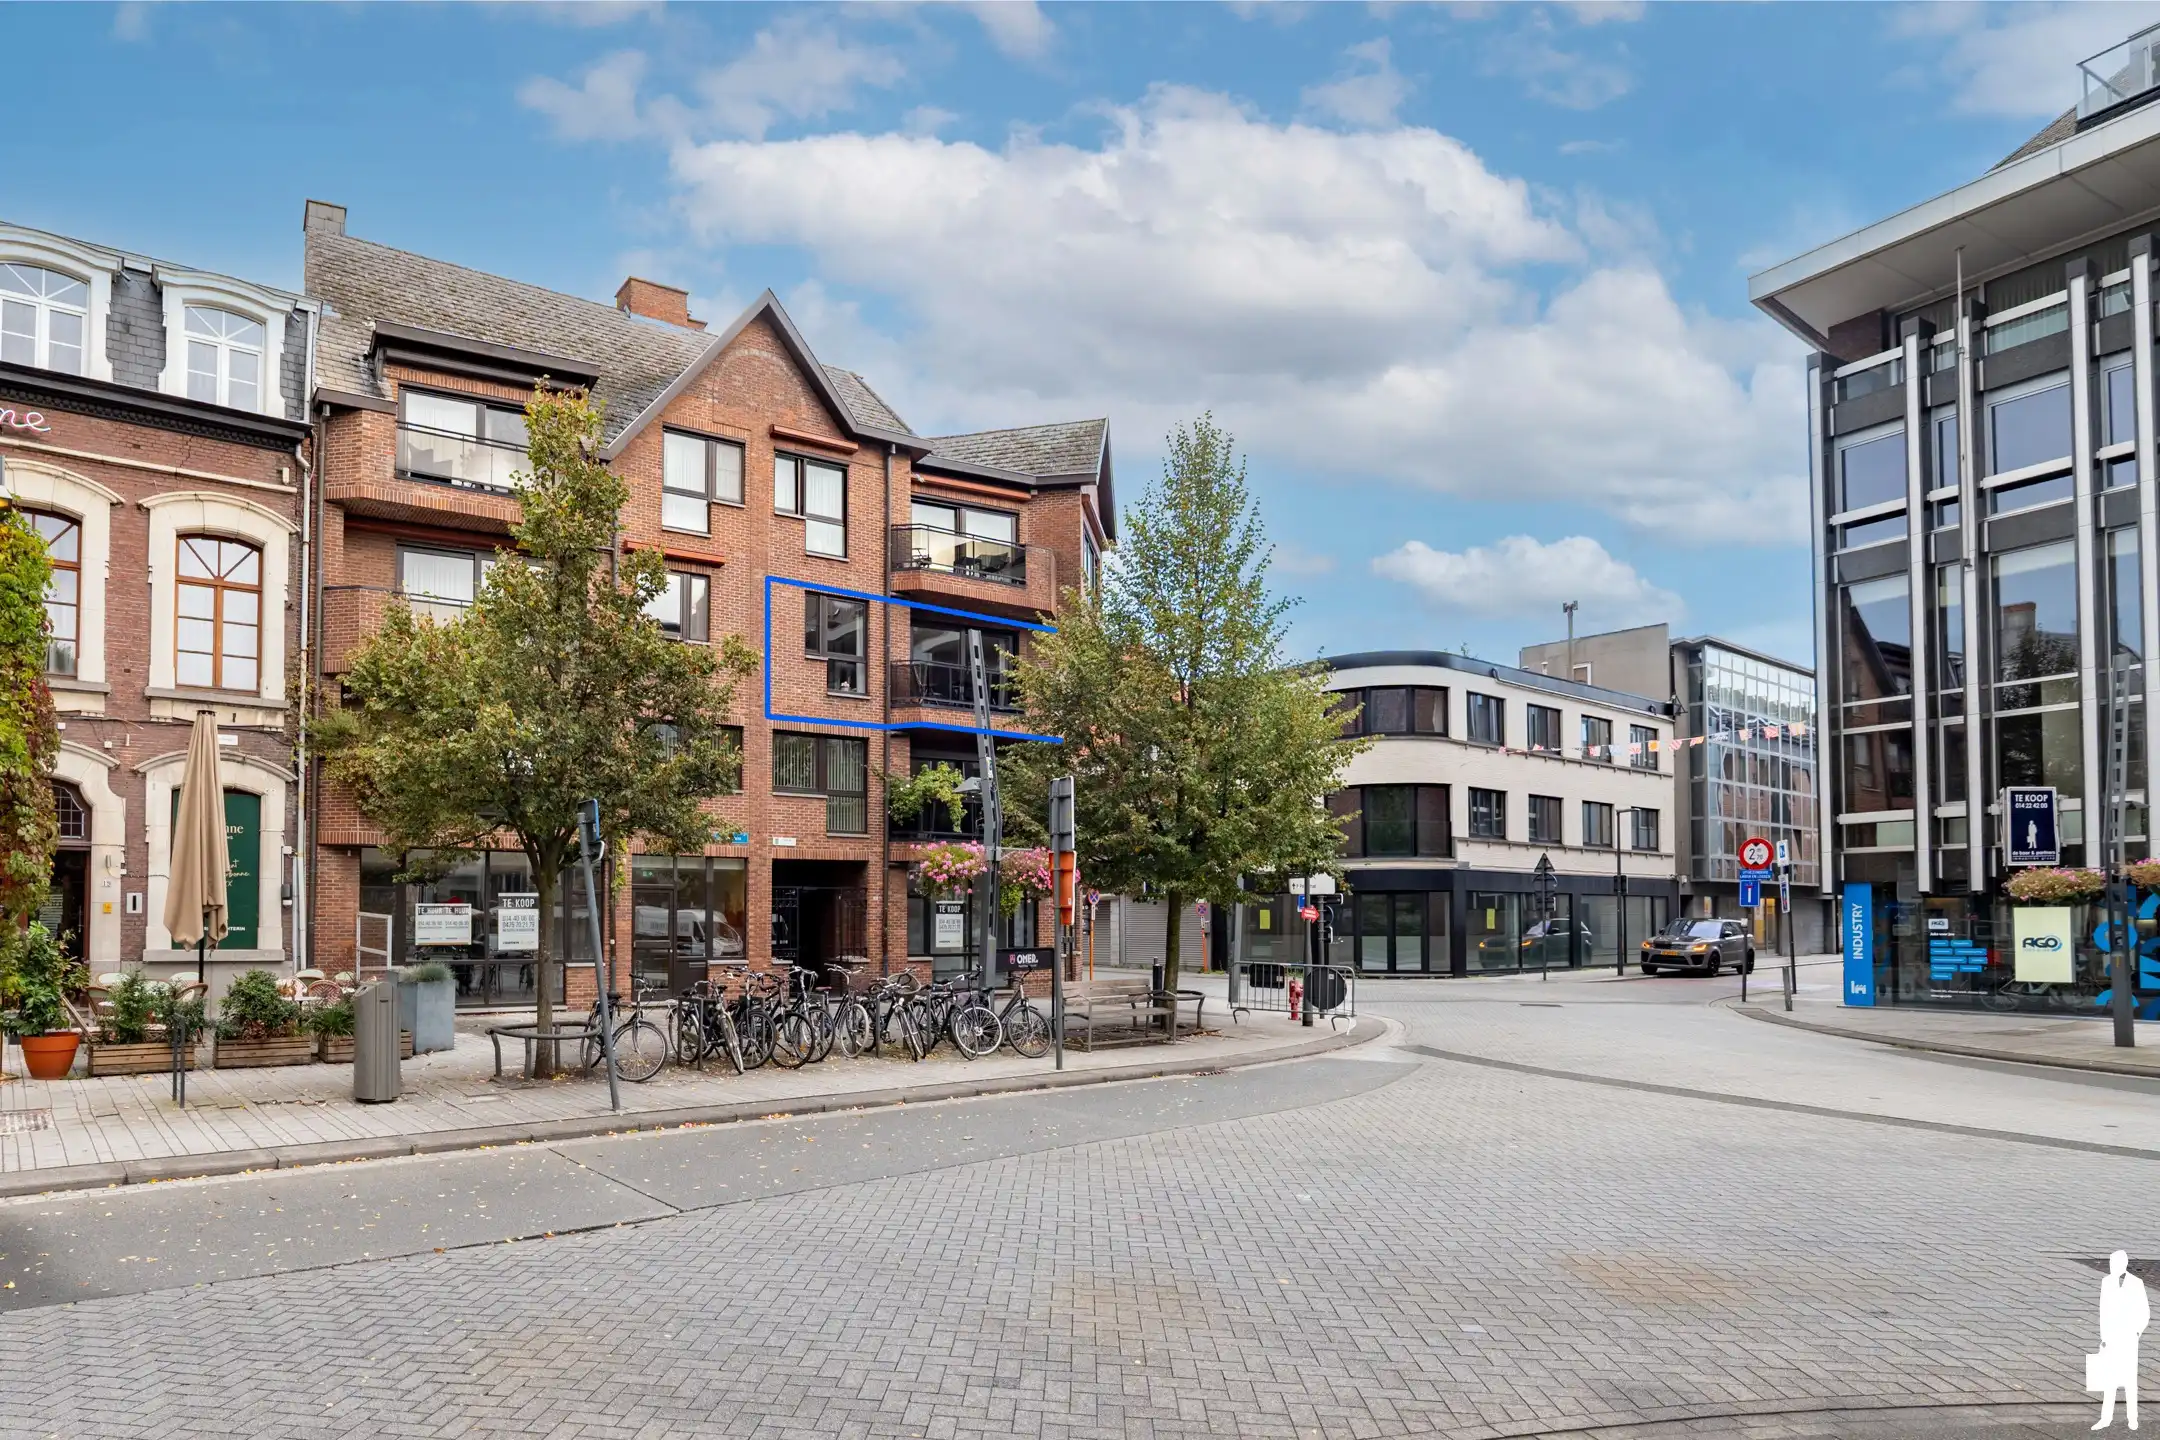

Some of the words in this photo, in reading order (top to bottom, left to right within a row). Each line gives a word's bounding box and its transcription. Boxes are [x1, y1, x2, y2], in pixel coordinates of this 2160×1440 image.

[1749, 848, 1756, 860] 2
[502, 898, 512, 908] TE
[515, 898, 535, 908] KOOP
[938, 905, 946, 913] TE
[947, 905, 961, 913] KOOP
[1852, 903, 1864, 960] INDUSTRY
[2022, 936, 2060, 949] AGO
